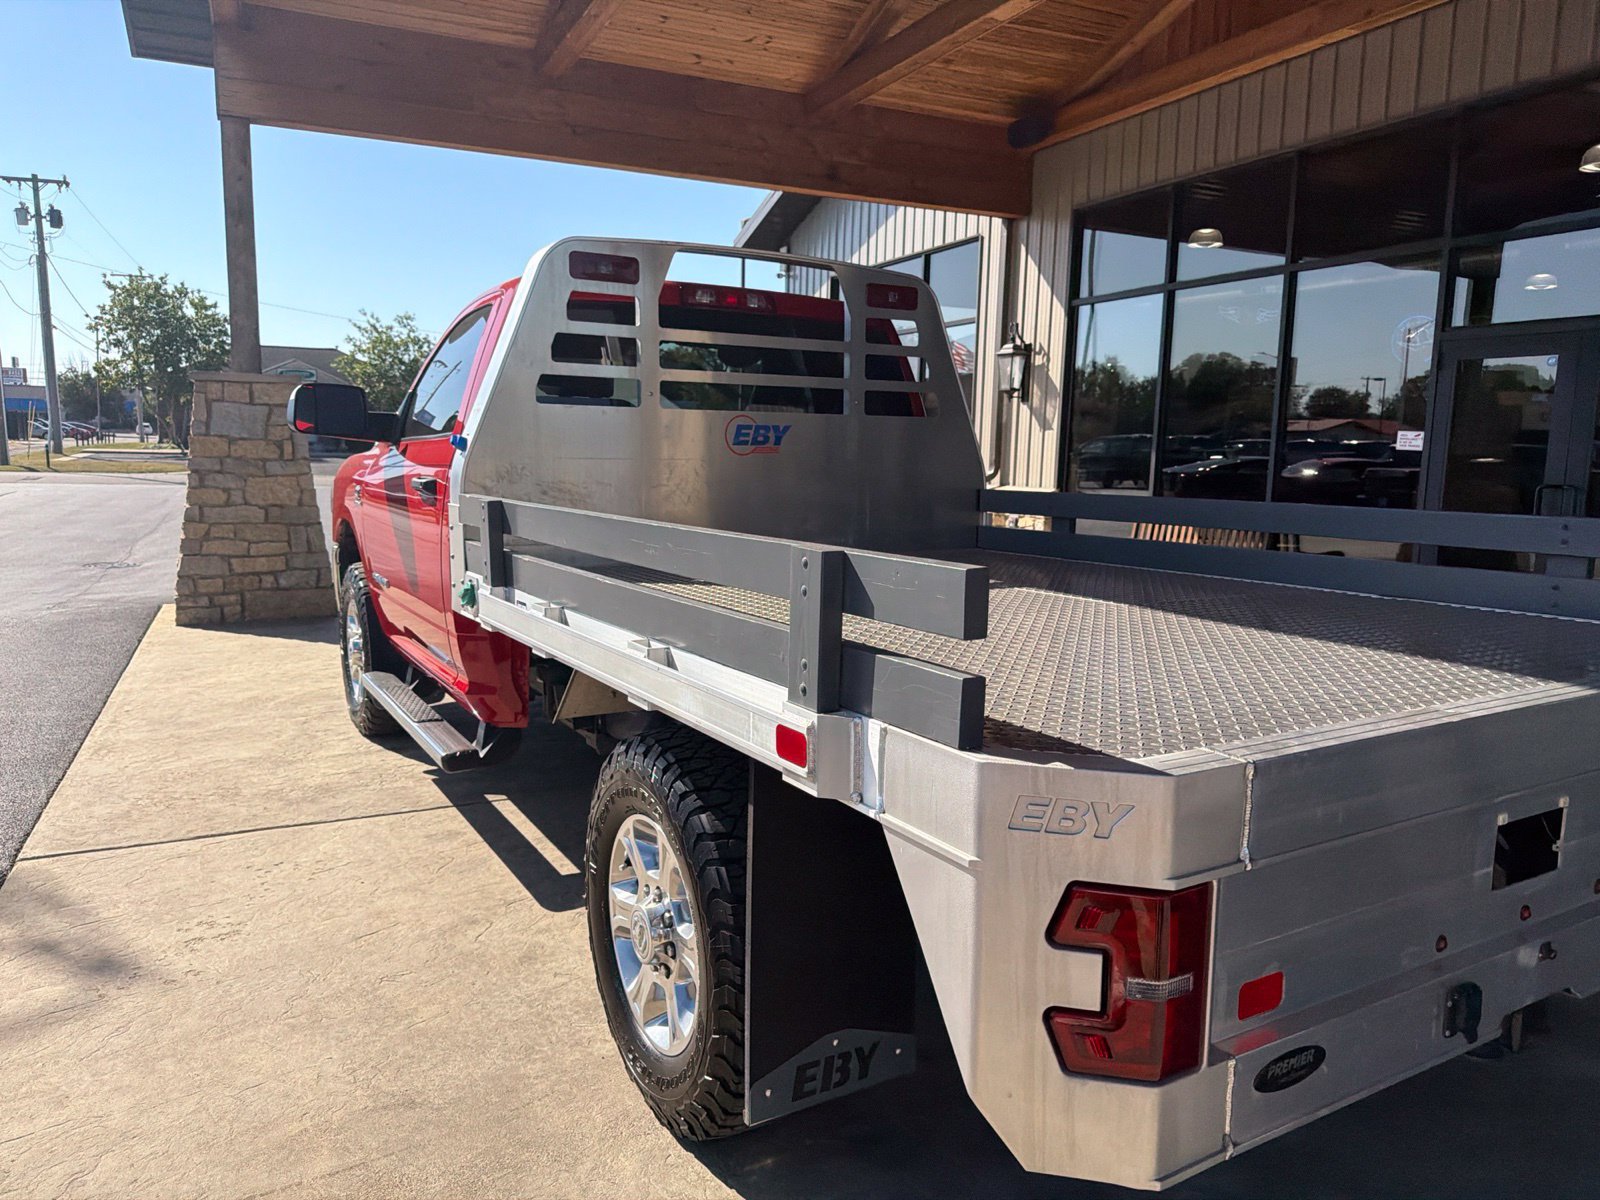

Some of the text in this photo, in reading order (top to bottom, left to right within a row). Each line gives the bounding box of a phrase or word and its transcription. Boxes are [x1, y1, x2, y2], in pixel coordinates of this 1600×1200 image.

[732, 424, 792, 446] EBY
[1008, 795, 1136, 839] EBY
[791, 1040, 881, 1103] EBY
[1267, 1048, 1315, 1079] PREMIER
